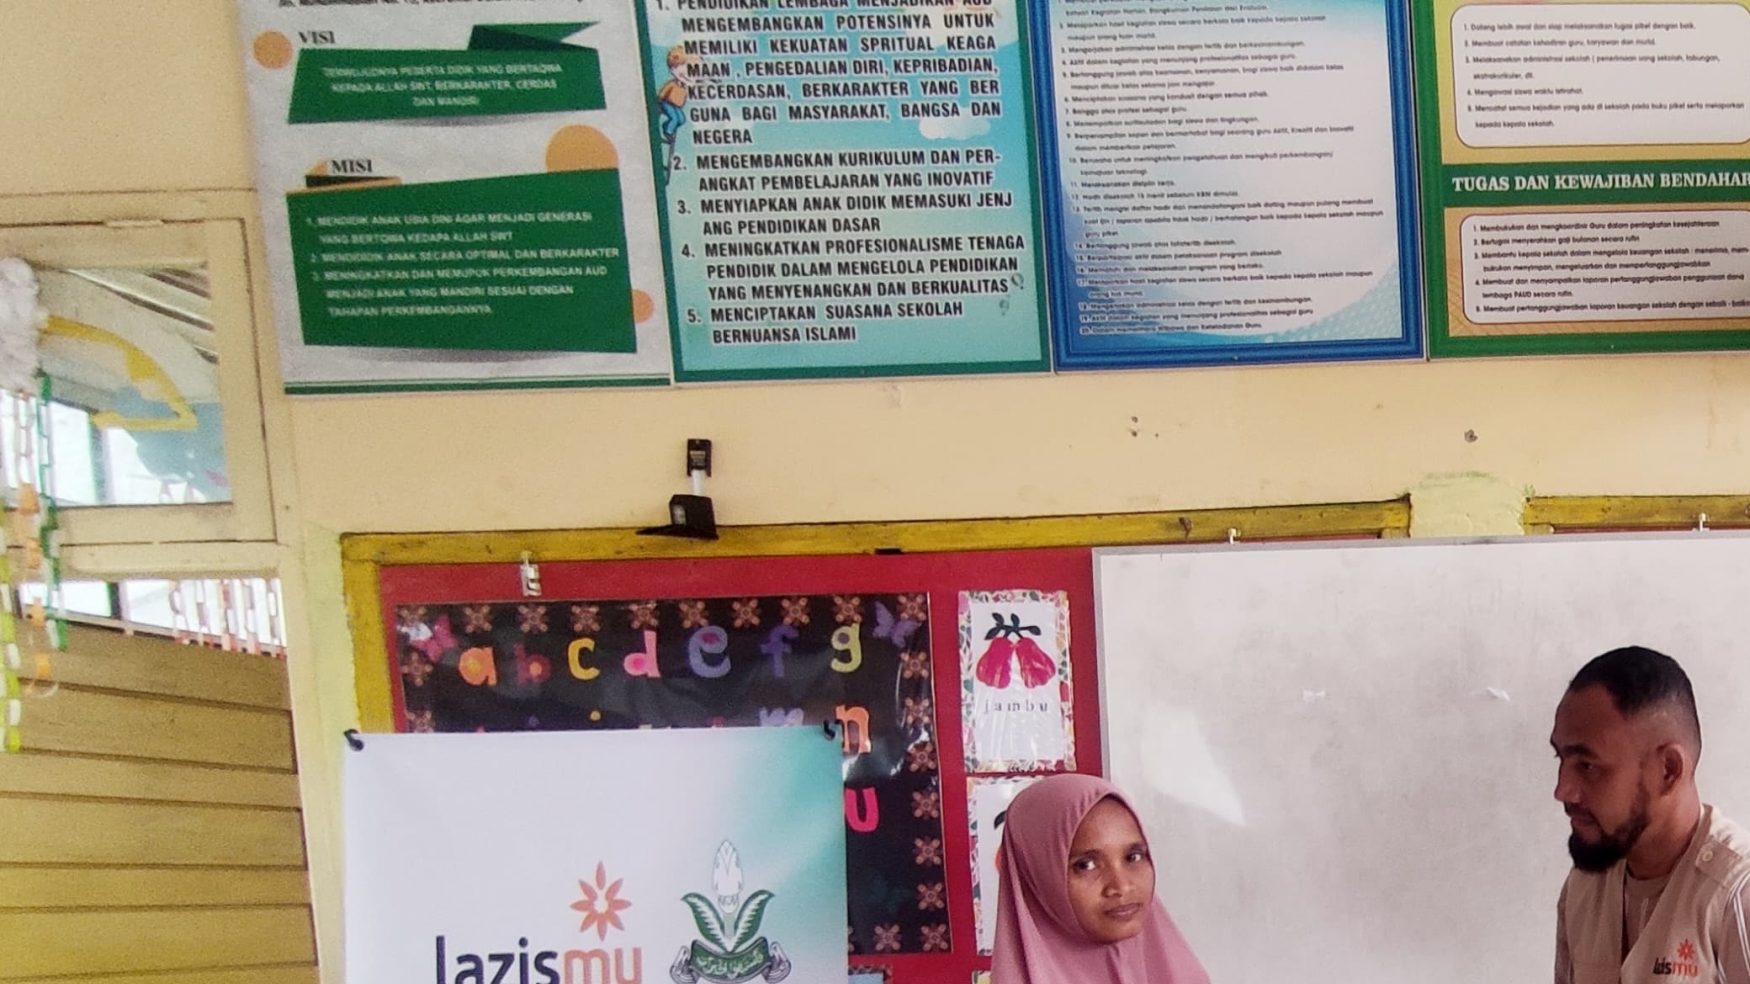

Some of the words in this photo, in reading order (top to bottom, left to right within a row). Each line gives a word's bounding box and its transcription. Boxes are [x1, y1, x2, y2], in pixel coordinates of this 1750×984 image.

[682, 16, 824, 32] MENGEMBANGKAN
[836, 14, 931, 30] POTENSINYA
[943, 13, 994, 28] UNTUK
[298, 31, 336, 44] VISI
[683, 40, 758, 55] MEMILIKI
[770, 38, 847, 53] KEKUATAN
[861, 37, 934, 51] SPRITUAL
[947, 36, 996, 50] KEAGA
[687, 63, 730, 77] MAAN
[745, 60, 847, 76] PENGEDALIAN
[853, 60, 889, 75] DIRI,
[894, 58, 998, 74] KEPRIBADIAN,
[688, 84, 791, 100] KECERDASAN,
[802, 82, 909, 98] BERKARAKTER
[920, 80, 959, 95] YANG
[970, 80, 999, 95] BER
[690, 107, 731, 122] GUNA
[742, 106, 777, 120] BAGI
[789, 104, 890, 120] MASYARAKAT,
[901, 102, 960, 118] BANGSA
[971, 102, 1001, 116] DAN
[693, 129, 752, 145] NEGERA
[331, 160, 373, 173] MISI
[673, 156, 687, 171] 2.
[697, 153, 833, 170] MENGEMBANGKAN
[839, 151, 925, 167] KURIKULUM
[931, 150, 960, 165] DAN
[966, 149, 1001, 164] PER-
[699, 177, 755, 192] ANGKAT
[761, 174, 879, 190] PEMBELAJARAN
[884, 173, 922, 187] YANG
[927, 171, 993, 186] INOVATIF
[1453, 176, 1510, 192] TUGAS
[1514, 175, 1549, 190] DAN
[1554, 173, 1655, 190] KEWAJIBAN
[677, 200, 691, 214] 3.
[701, 197, 797, 214] MENYIAPKAN
[803, 196, 842, 211] ANAK
[847, 195, 886, 210] DIDIK
[892, 194, 971, 209] MEMASUKI
[976, 192, 1012, 207] JENJ
[703, 221, 733, 235] ANG
[738, 219, 827, 234] PENDIDIKAN
[832, 217, 880, 232] DASAR
[682, 244, 695, 258] 4.
[705, 241, 820, 257] MENINGKATKAN
[826, 237, 963, 254] PROFESIONALISME
[968, 235, 1025, 250] TENAGA
[707, 264, 776, 279] PENDIDIK
[781, 262, 832, 277] DALAM
[838, 260, 925, 276] MENGELOLA
[930, 257, 1018, 273] PENDIDIKAN
[708, 286, 746, 301] YANG
[752, 283, 871, 299] MENYENANGKAN
[877, 282, 907, 296] DAN
[911, 278, 1008, 295] BERKUALITAS
[687, 309, 701, 323] 5.
[711, 306, 816, 322] MENCIPTAKAN
[826, 304, 892, 319] SUASANA
[898, 301, 963, 317] SEKOLAH
[713, 328, 801, 343] BERNUANSA
[806, 326, 856, 341] ISLAMI
[458, 646, 497, 686] a
[568, 638, 600, 680] c
[623, 630, 661, 678] d
[688, 625, 731, 678] e
[830, 622, 863, 673] g
